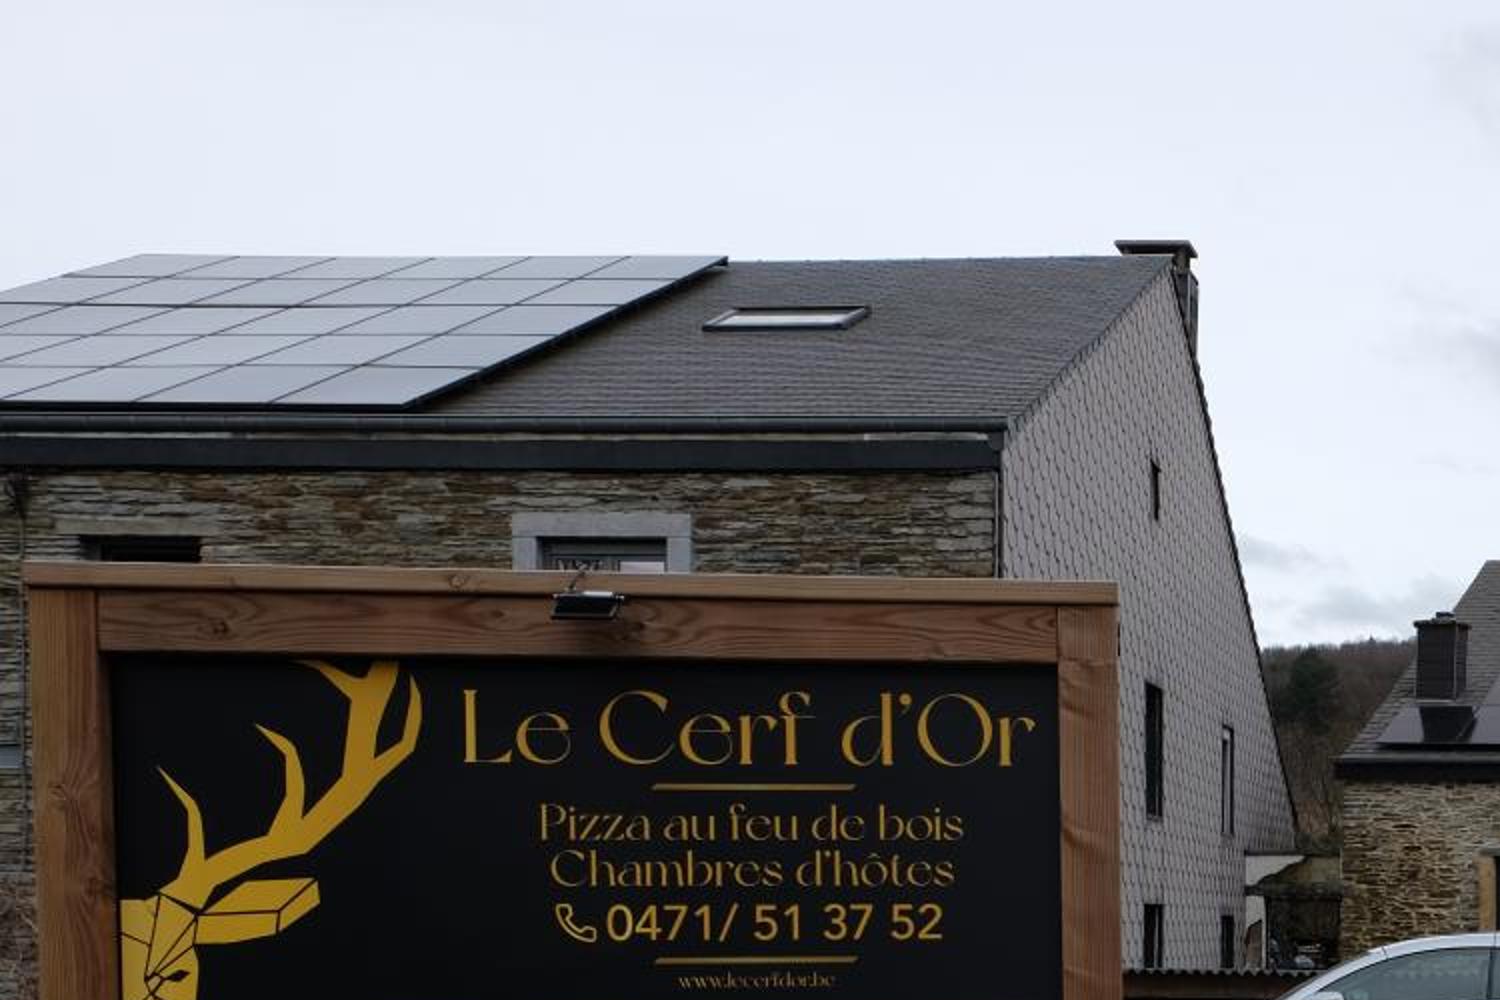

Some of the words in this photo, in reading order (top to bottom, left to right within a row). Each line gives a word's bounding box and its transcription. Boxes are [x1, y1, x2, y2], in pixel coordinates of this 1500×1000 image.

[463, 688, 572, 765] Le
[599, 689, 815, 768] Cerf
[841, 691, 1036, 768] d'Or
[539, 802, 650, 841] Pizza
[663, 815, 716, 841] au
[730, 802, 799, 841] feu
[811, 804, 864, 841] de
[878, 802, 962, 841] bois
[549, 848, 783, 888] Chambres
[795, 850, 954, 887] d'hôtes
[606, 902, 738, 943] 0471/
[752, 902, 800, 941] 51
[822, 902, 873, 941] 37
[889, 902, 943, 941] 52
